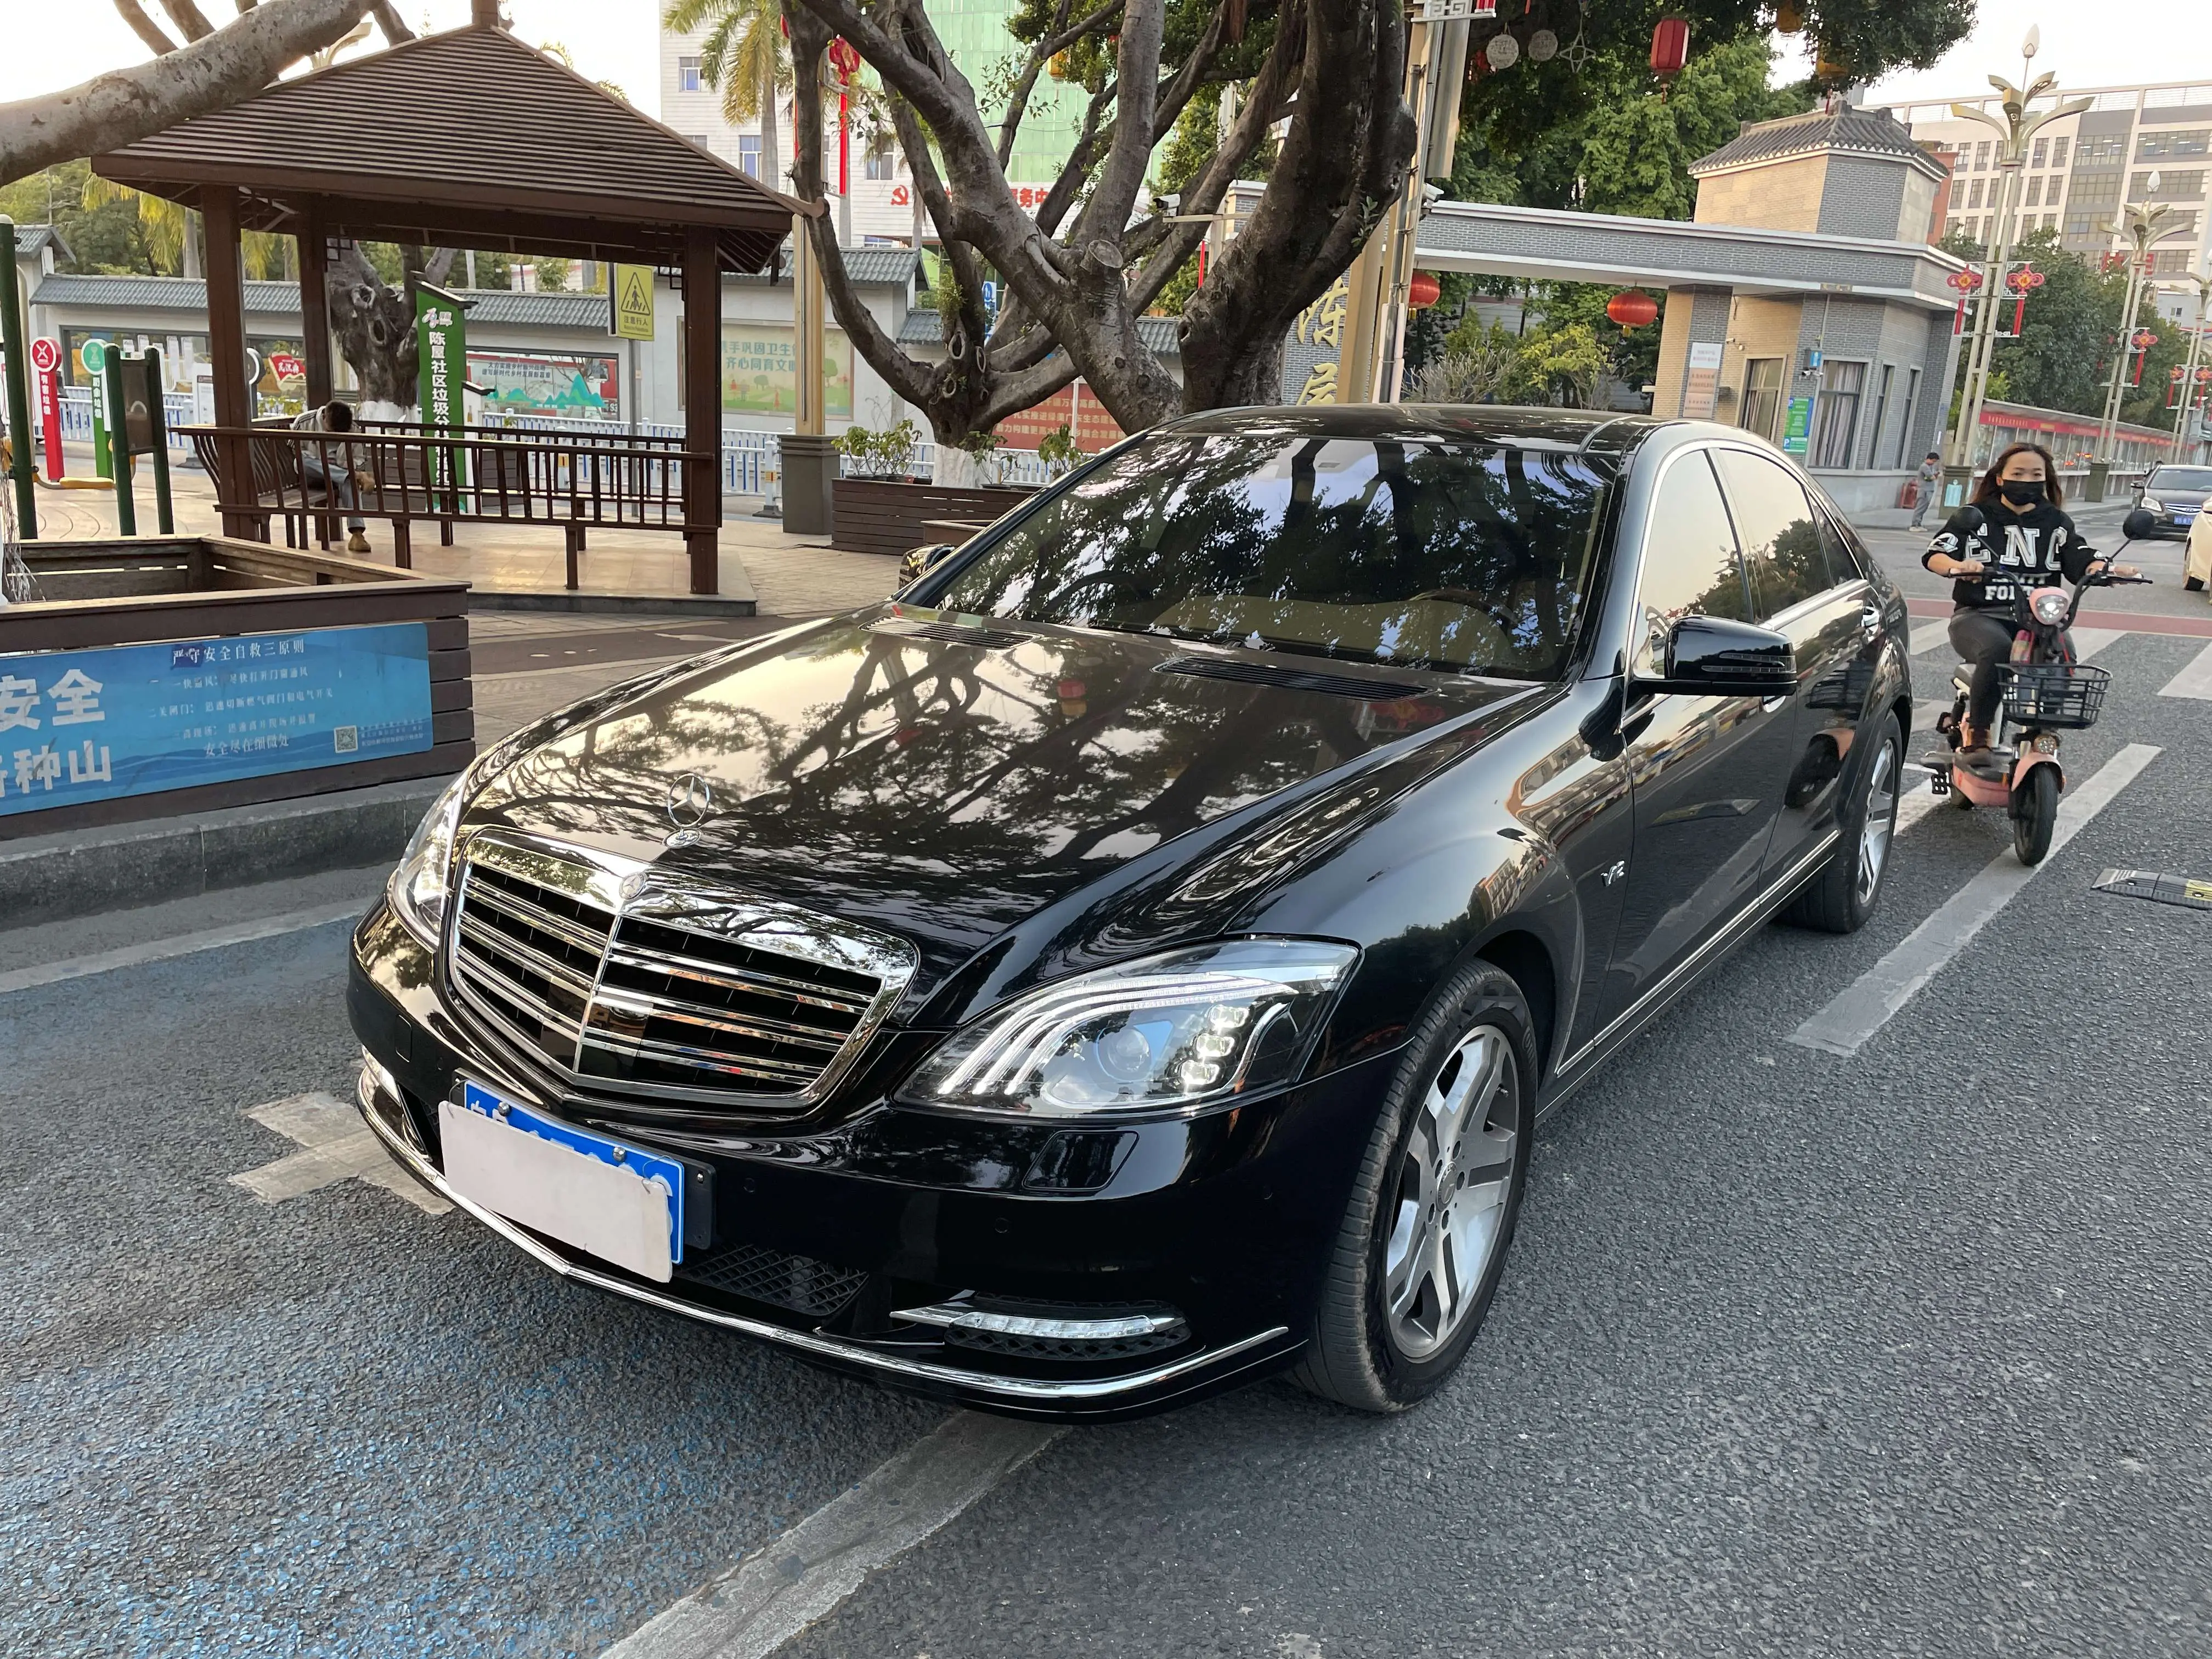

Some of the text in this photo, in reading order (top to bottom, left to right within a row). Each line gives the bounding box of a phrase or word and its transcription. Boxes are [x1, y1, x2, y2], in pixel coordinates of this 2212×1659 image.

[624, 315, 648, 326] 注意行人
[721, 340, 795, 356] 手巩固卫生
[172, 639, 305, 665] 严守安全自救三原则
[0, 669, 105, 732] 安全
